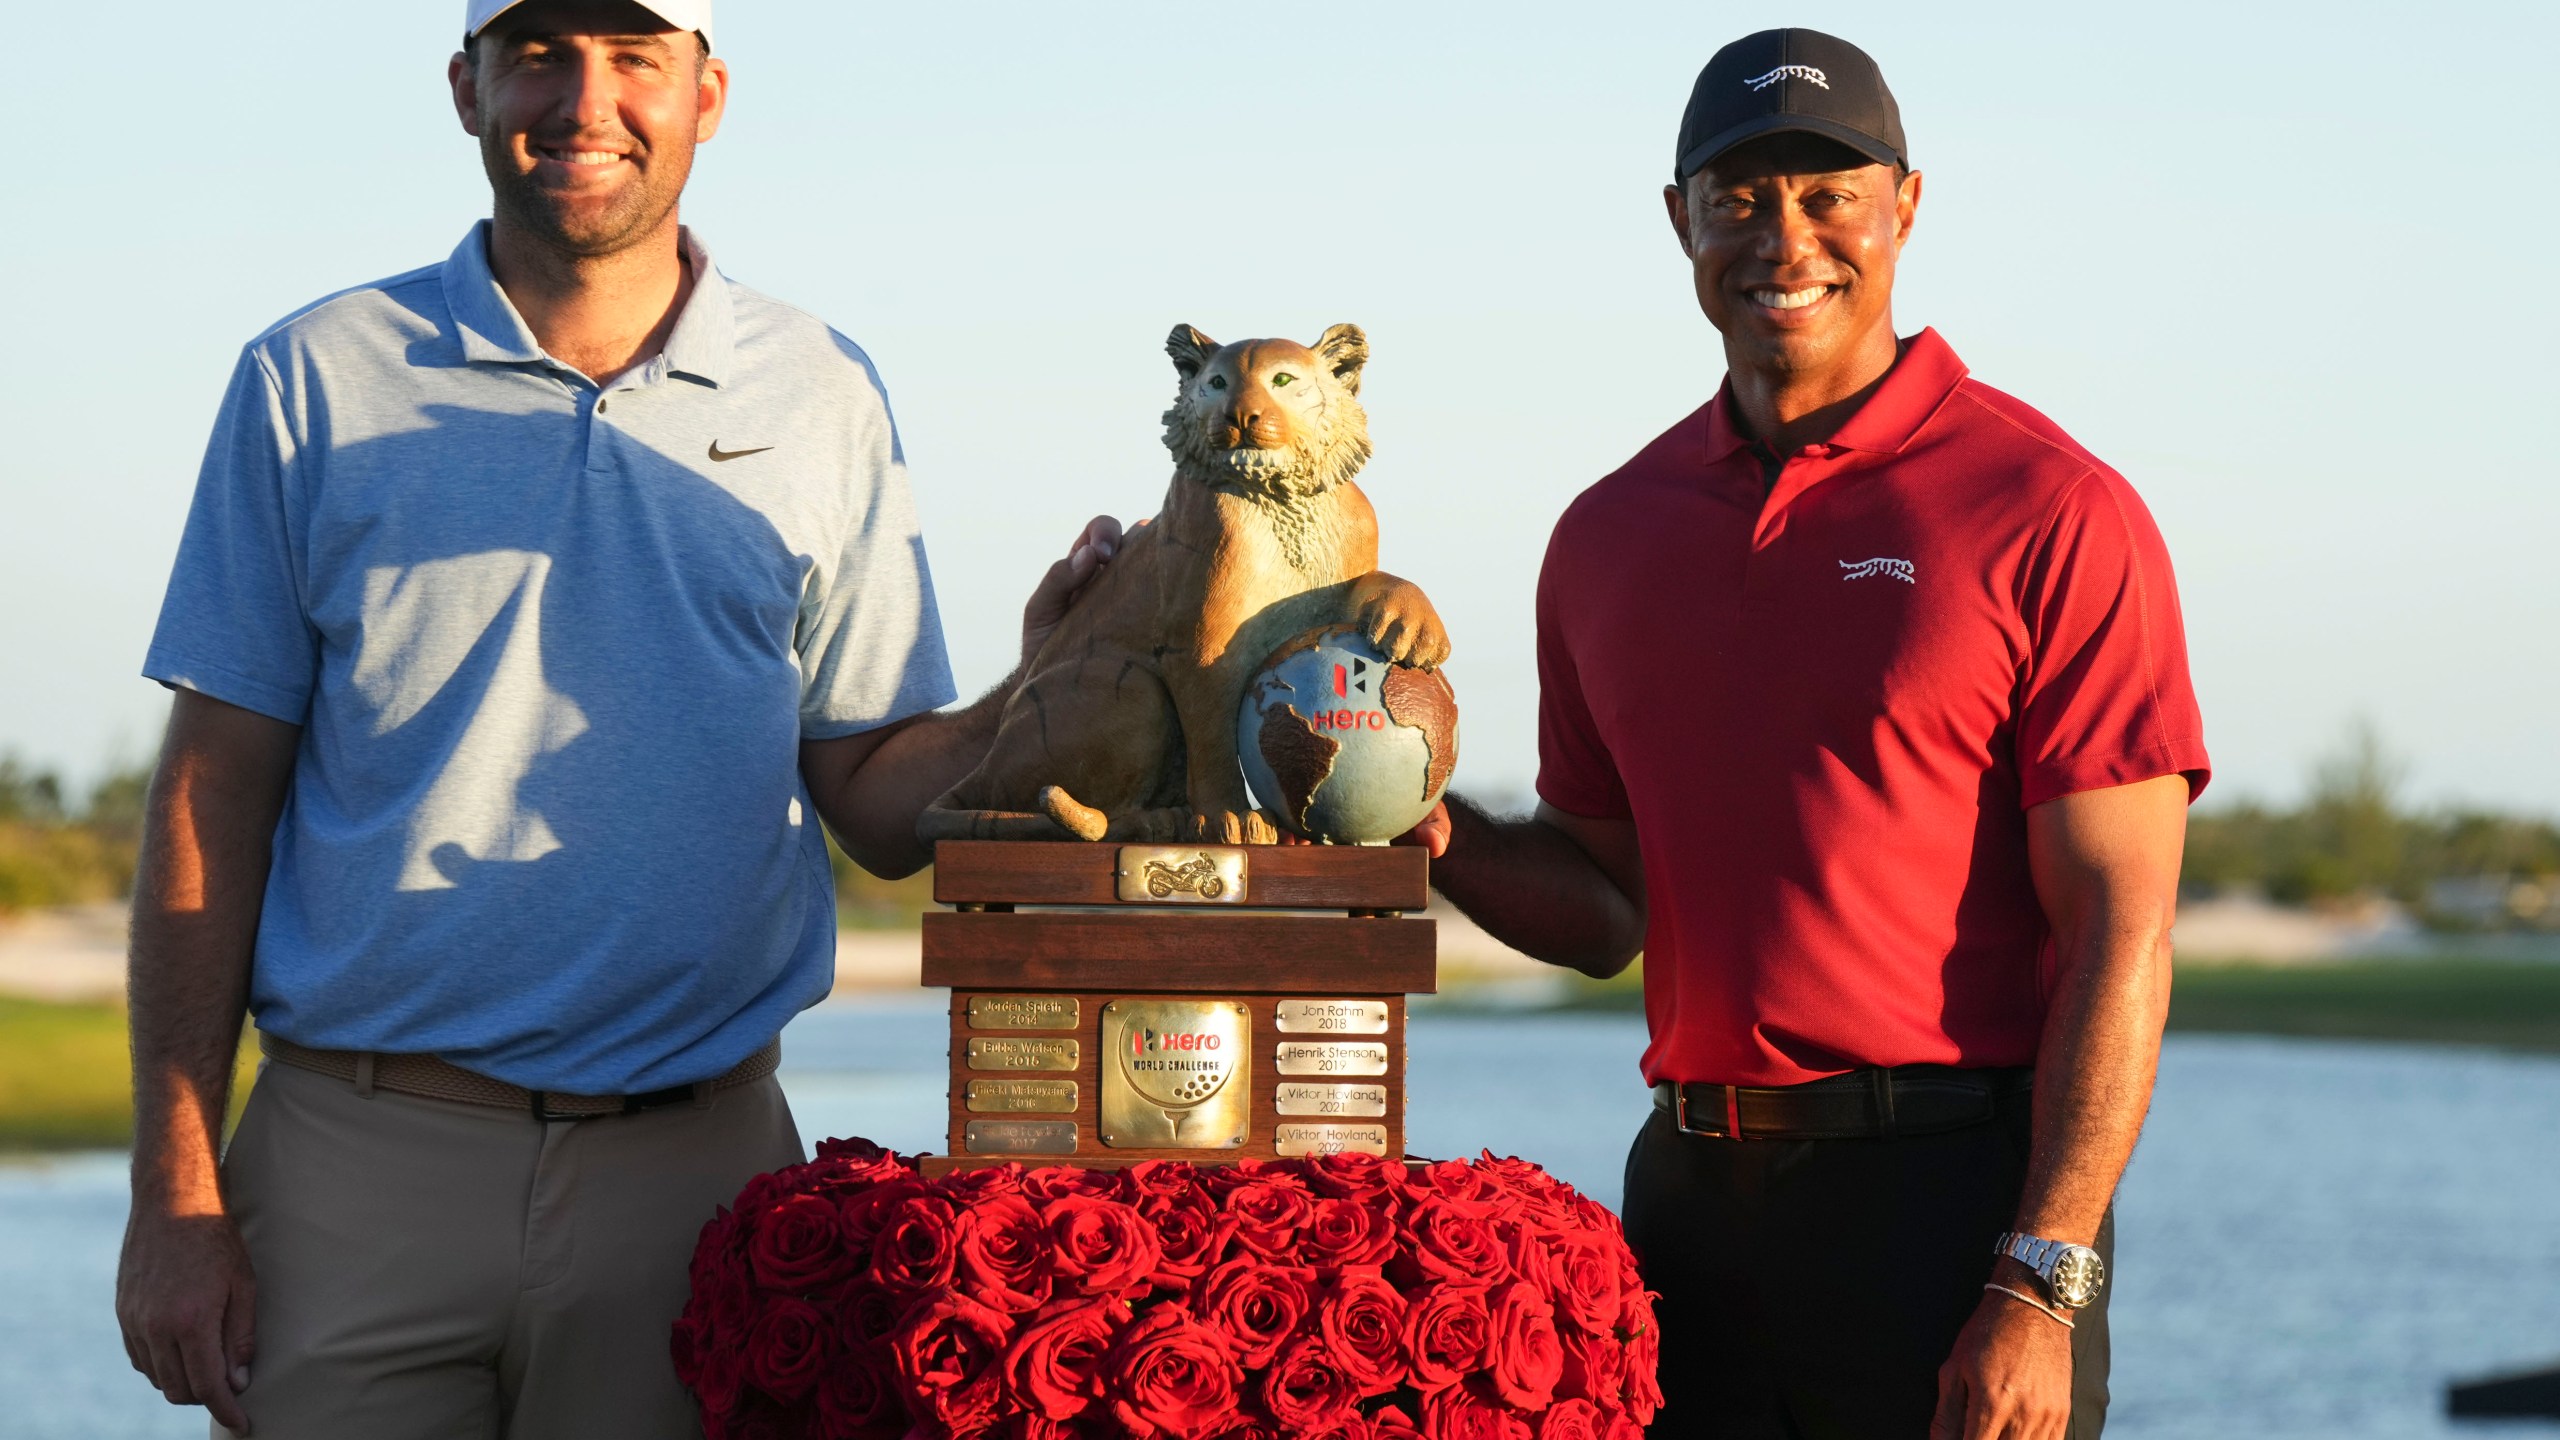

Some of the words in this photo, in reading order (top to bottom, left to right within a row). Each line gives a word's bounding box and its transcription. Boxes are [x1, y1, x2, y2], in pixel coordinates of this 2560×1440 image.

[1313, 709, 1385, 731] Hero
[985, 1001, 1021, 1013] Jordan
[1025, 1001, 1062, 1014] Spieth
[1302, 1006, 1325, 1017] Jon
[1328, 1006, 1364, 1017] Rahm
[1008, 1014, 1038, 1025] 2014
[1318, 1018, 1347, 1030] 2018
[983, 1042, 1017, 1053] Bubba
[1021, 1042, 1064, 1054] Watson
[1161, 1033, 1221, 1051] Hero
[1288, 1047, 1326, 1058] Henrik
[1329, 1047, 1377, 1059] Stenson
[1005, 1056, 1041, 1067] 2015
[1133, 1060, 1164, 1071] WORLD
[1168, 1060, 1220, 1071] CHALLENGE
[1318, 1060, 1347, 1072] 2019
[975, 1084, 1007, 1096] Hideki
[1011, 1084, 1070, 1098] Matsuyama
[1288, 1088, 1322, 1100] Viktor
[1327, 1088, 1377, 1101] Hovland
[1008, 1097, 1037, 1109] 2016
[1319, 1101, 1346, 1113] 2021
[1287, 1129, 1321, 1140] Viktor
[1327, 1129, 1377, 1141] Hovland
[1318, 1142, 1346, 1153] 2022
